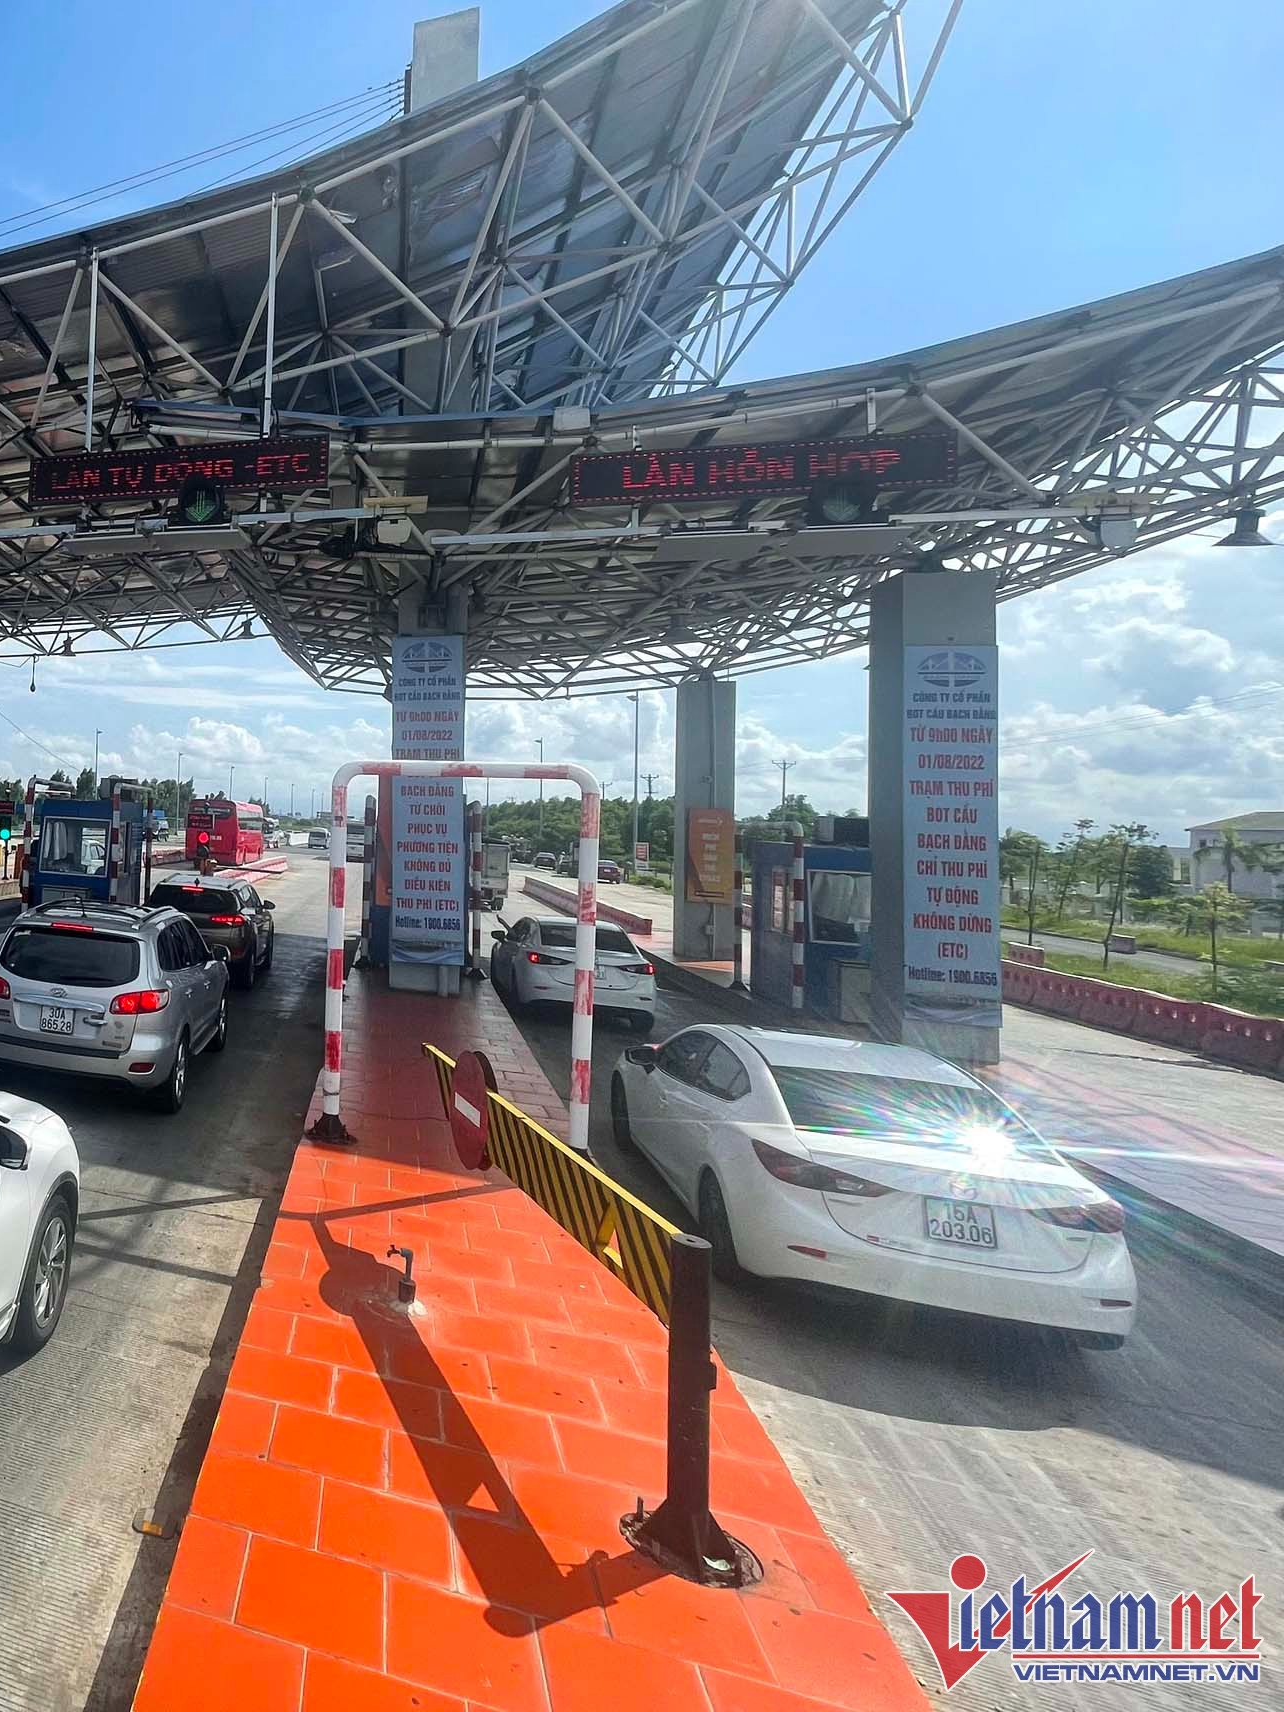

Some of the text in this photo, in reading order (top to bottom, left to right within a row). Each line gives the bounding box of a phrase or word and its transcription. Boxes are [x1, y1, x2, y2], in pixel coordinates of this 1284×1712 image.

[940, 692, 950, 702] TY
[910, 724, 926, 742] TỪ
[961, 725, 994, 744] NGÀY
[918, 753, 985, 770] 01/08/2022
[909, 779, 993, 798] TRẠM THU PHÍ
[926, 804, 978, 823] BOT CẦU
[917, 828, 987, 852] BẠCH ĐẰNG
[404, 858, 436, 873] KHÔNG
[917, 856, 988, 878] CHỈ THU PHÍ
[396, 897, 414, 910] THU
[435, 899, 459, 912] (ETC)
[926, 886, 979, 907] TỰ ĐỘNG
[912, 911, 955, 931] KHÔNG
[937, 942, 969, 960] (ETC)
[908, 966, 946, 982] Hotline:
[49, 1007, 66, 1019] 30A
[41, 1019, 72, 1032] 865.28
[944, 1202, 978, 1225] 15A
[929, 1218, 993, 1245] 203.06
